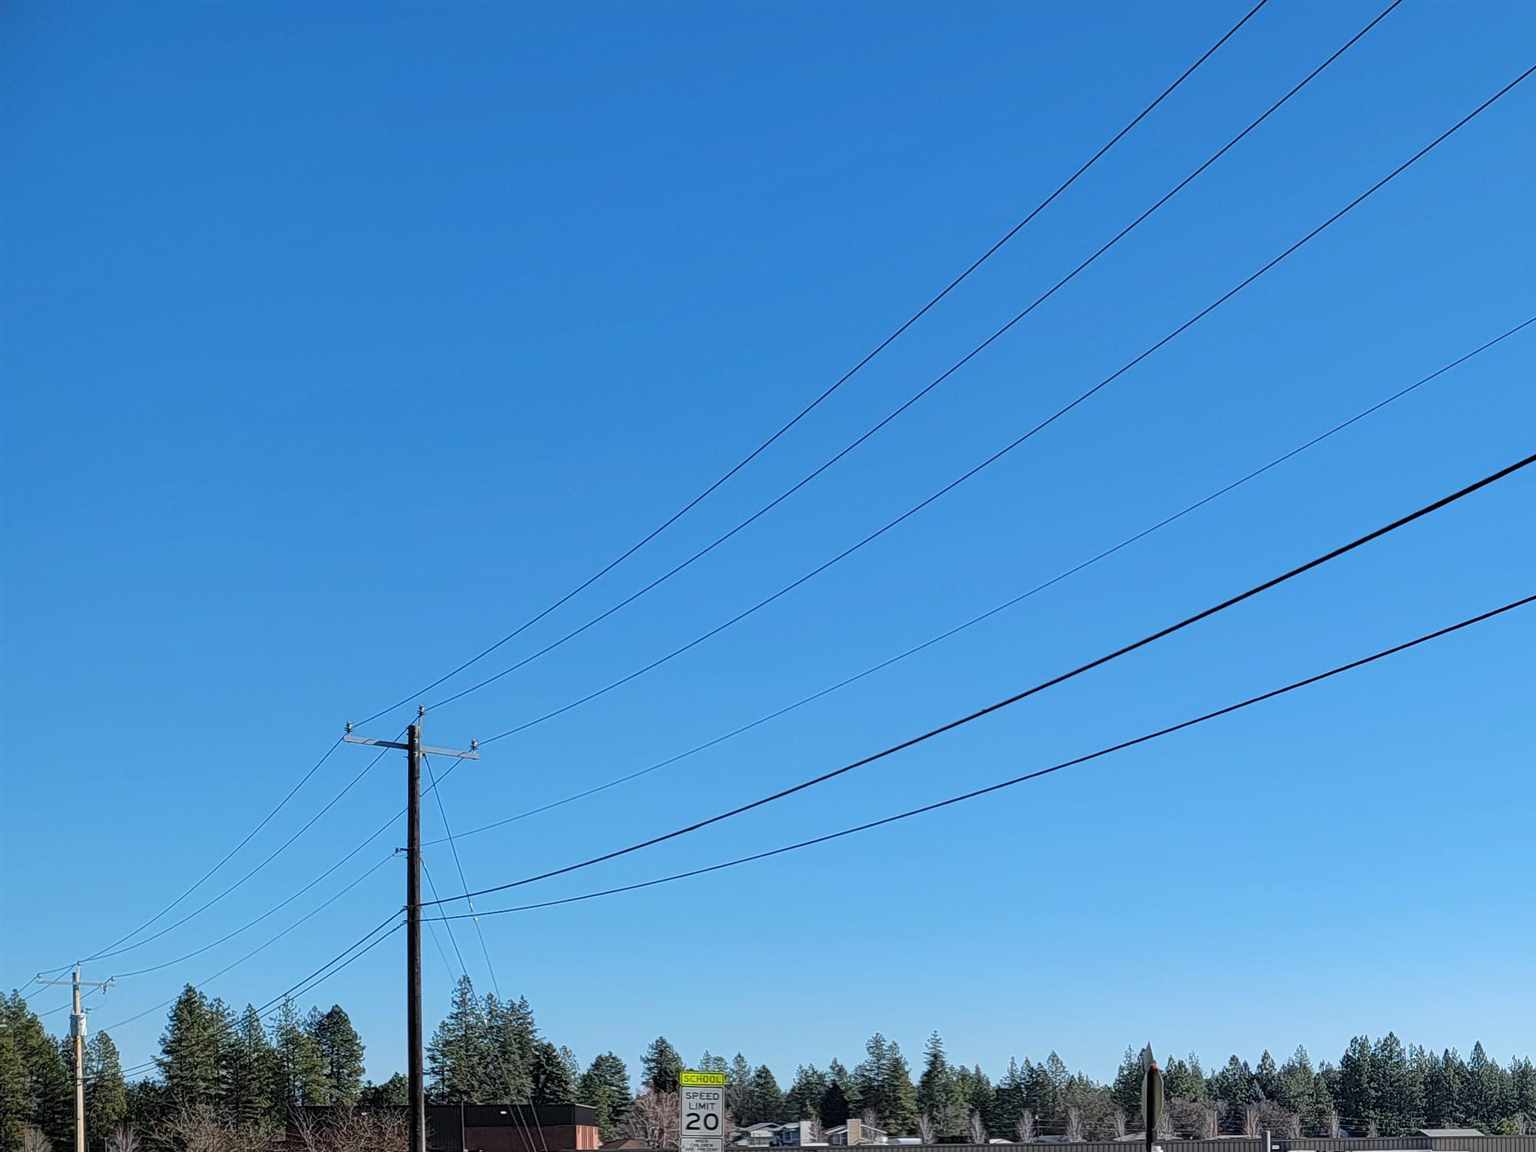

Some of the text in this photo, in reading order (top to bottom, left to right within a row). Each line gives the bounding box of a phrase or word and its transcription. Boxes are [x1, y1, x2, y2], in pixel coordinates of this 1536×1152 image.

[683, 1075, 722, 1083] SCHOOL
[686, 1092, 720, 1100] SPEED
[689, 1102, 716, 1110] LIMIT
[685, 1113, 719, 1130] 20
